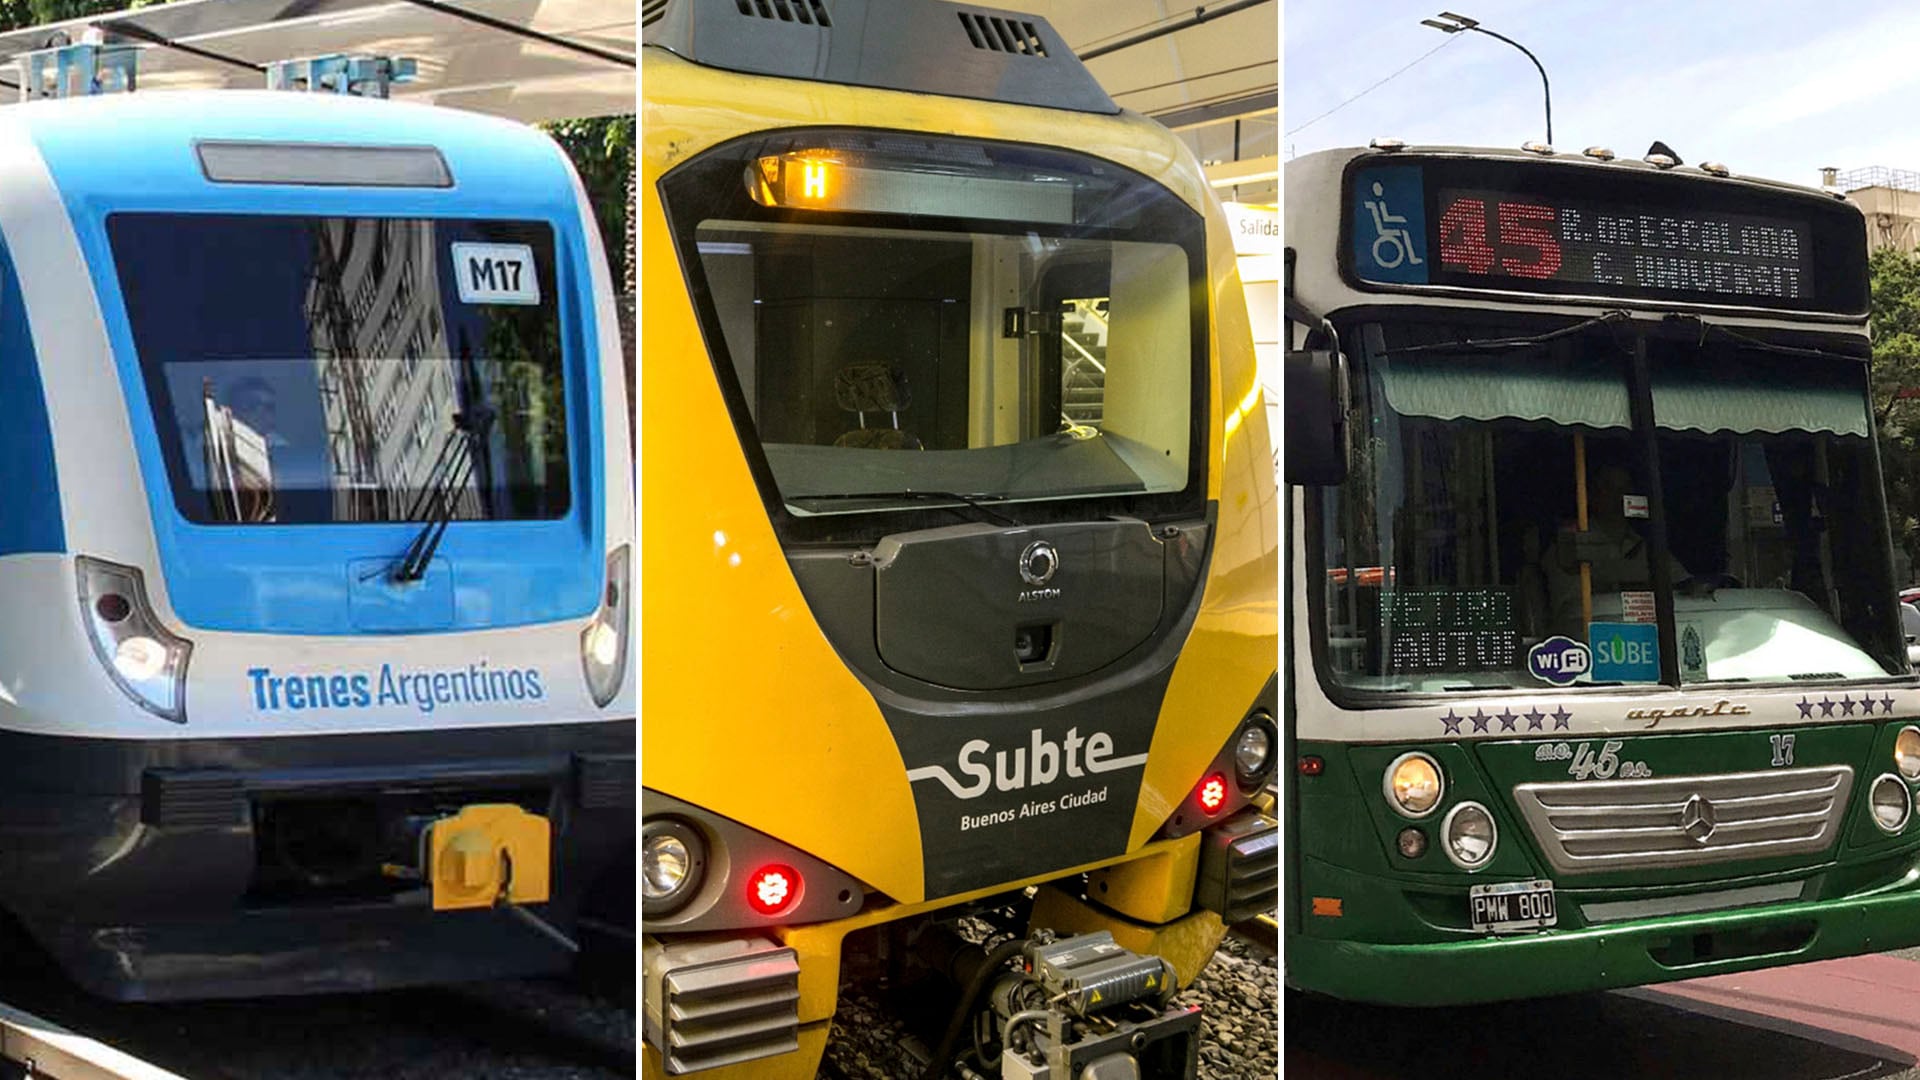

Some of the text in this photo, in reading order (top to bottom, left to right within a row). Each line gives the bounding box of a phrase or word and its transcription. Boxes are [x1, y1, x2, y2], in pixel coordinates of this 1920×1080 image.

[804, 162, 826, 199] H
[1239, 218, 1279, 237] Salida
[1439, 198, 1562, 280] 45
[468, 256, 523, 292] M17
[1017, 587, 1061, 602] ALSTOM
[1380, 589, 1511, 627] RETIRO
[1596, 637, 1654, 665] SUBE
[247, 660, 544, 713] Trenes Argentinos
[950, 726, 1122, 800] Subte
[1568, 740, 1624, 781] 45
[1769, 734, 1796, 767] 17
[960, 785, 1109, 832] Buenos Aires Ciudad
[1474, 892, 1553, 924] PMW 800
